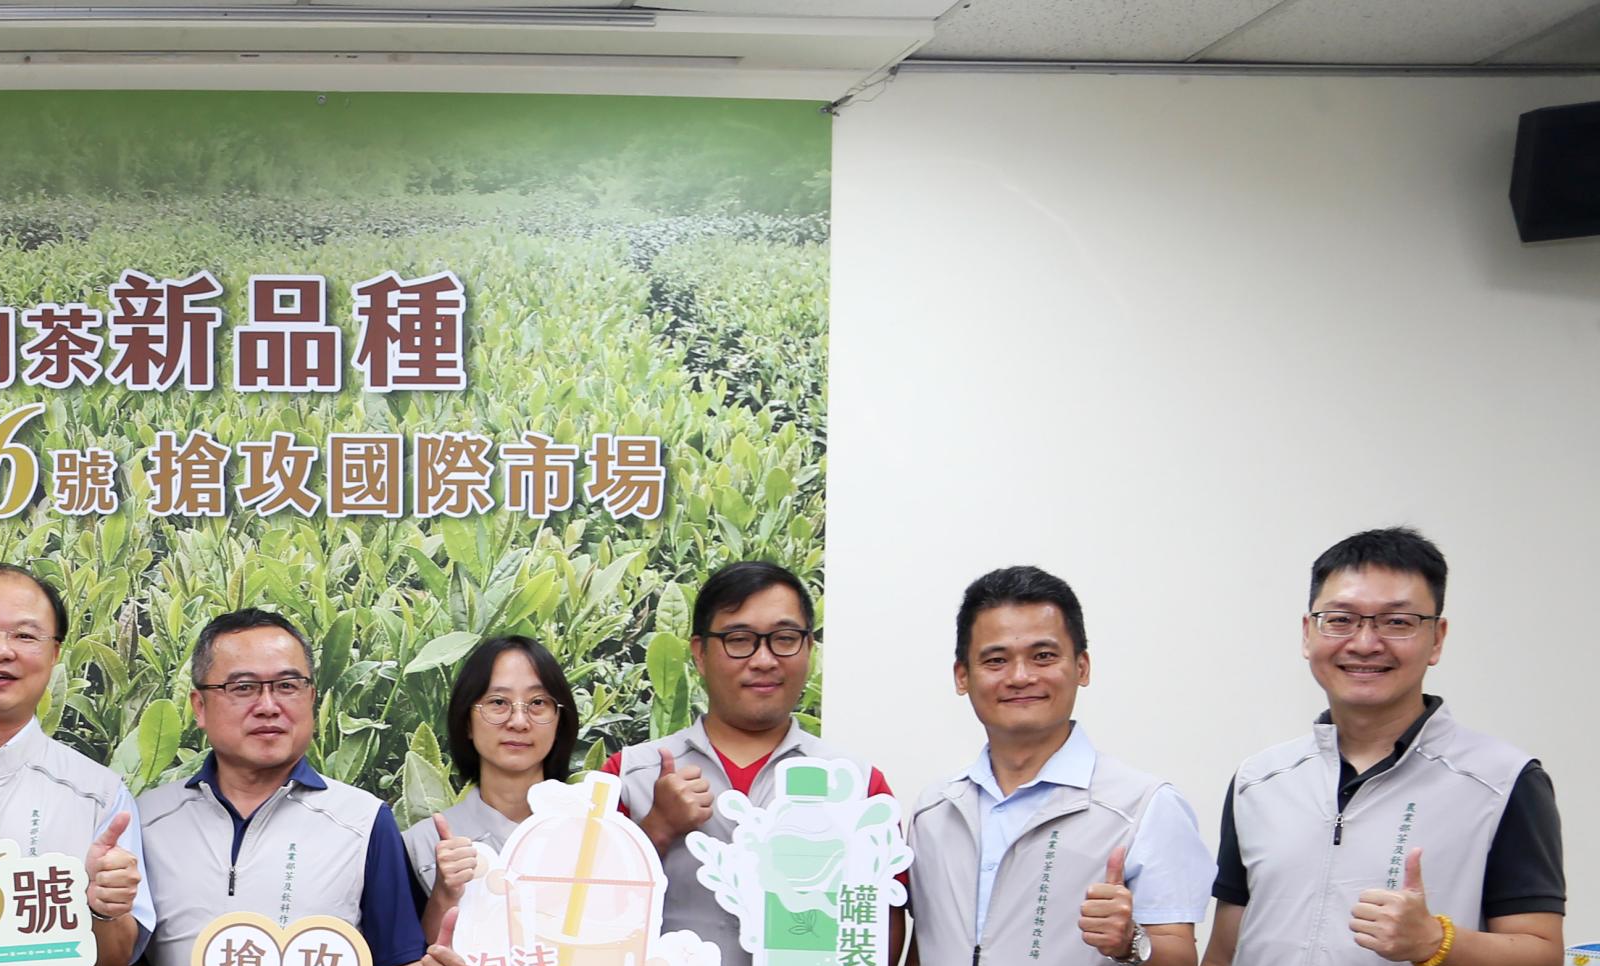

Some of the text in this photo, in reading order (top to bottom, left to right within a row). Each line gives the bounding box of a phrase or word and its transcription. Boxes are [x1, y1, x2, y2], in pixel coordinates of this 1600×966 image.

[151, 435, 667, 518] 搶攻國際市場
